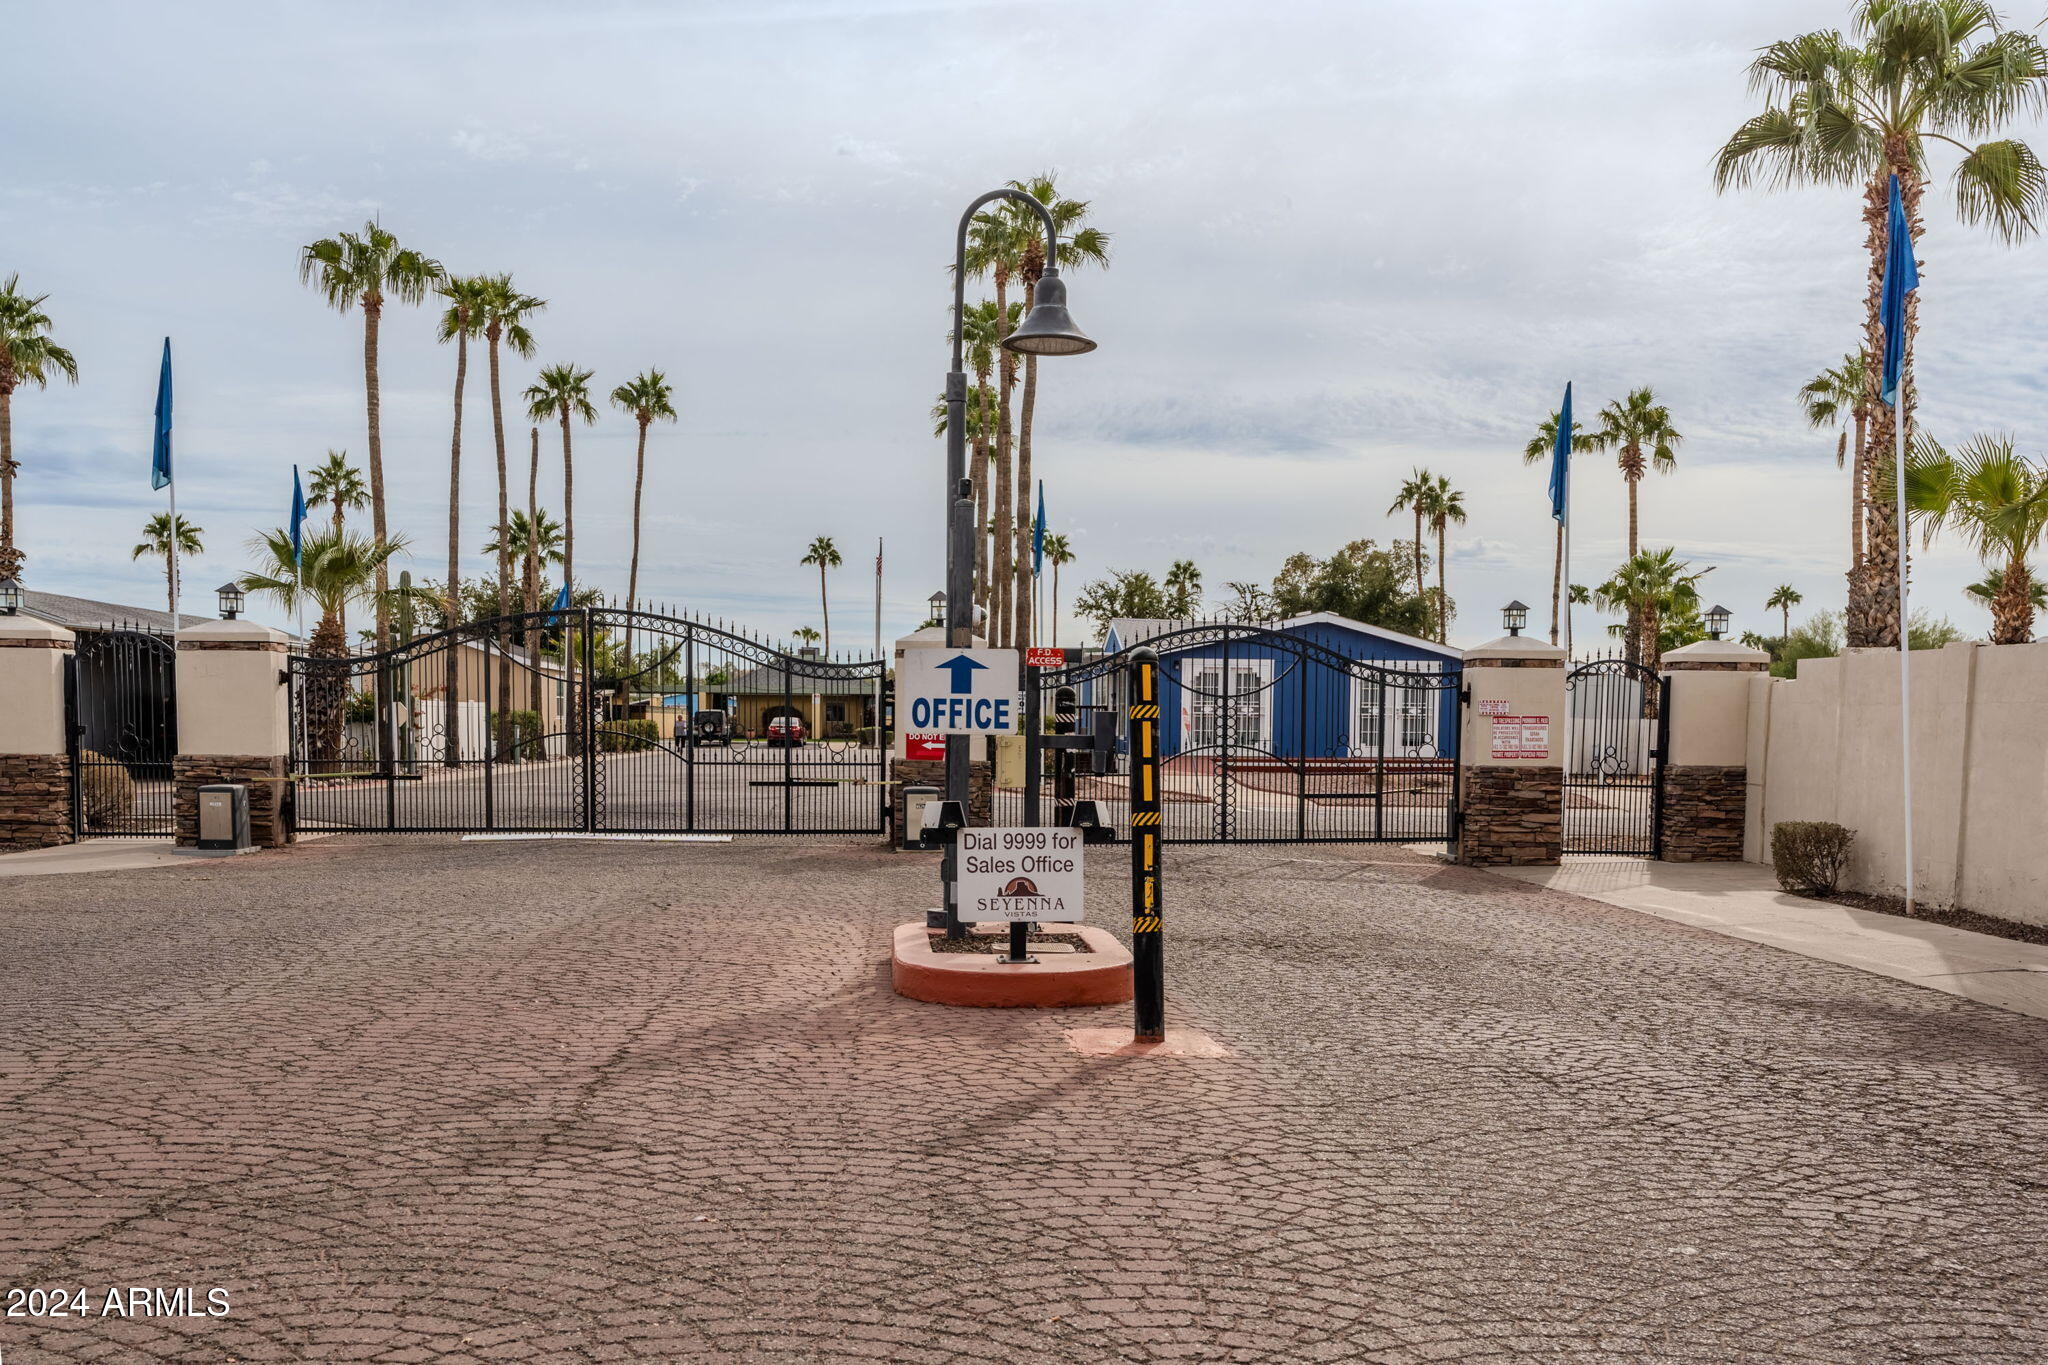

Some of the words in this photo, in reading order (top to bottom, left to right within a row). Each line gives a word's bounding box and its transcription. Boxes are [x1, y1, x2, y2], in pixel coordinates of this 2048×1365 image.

[1029, 657, 1063, 665] ACCESS
[912, 697, 1010, 729] OFFICE
[964, 832, 997, 850] Dial
[1003, 832, 1046, 850] 9999
[1052, 832, 1077, 850] for
[966, 855, 1015, 873] Sales
[1021, 855, 1074, 873] Office
[977, 897, 1065, 911] SEYENNA
